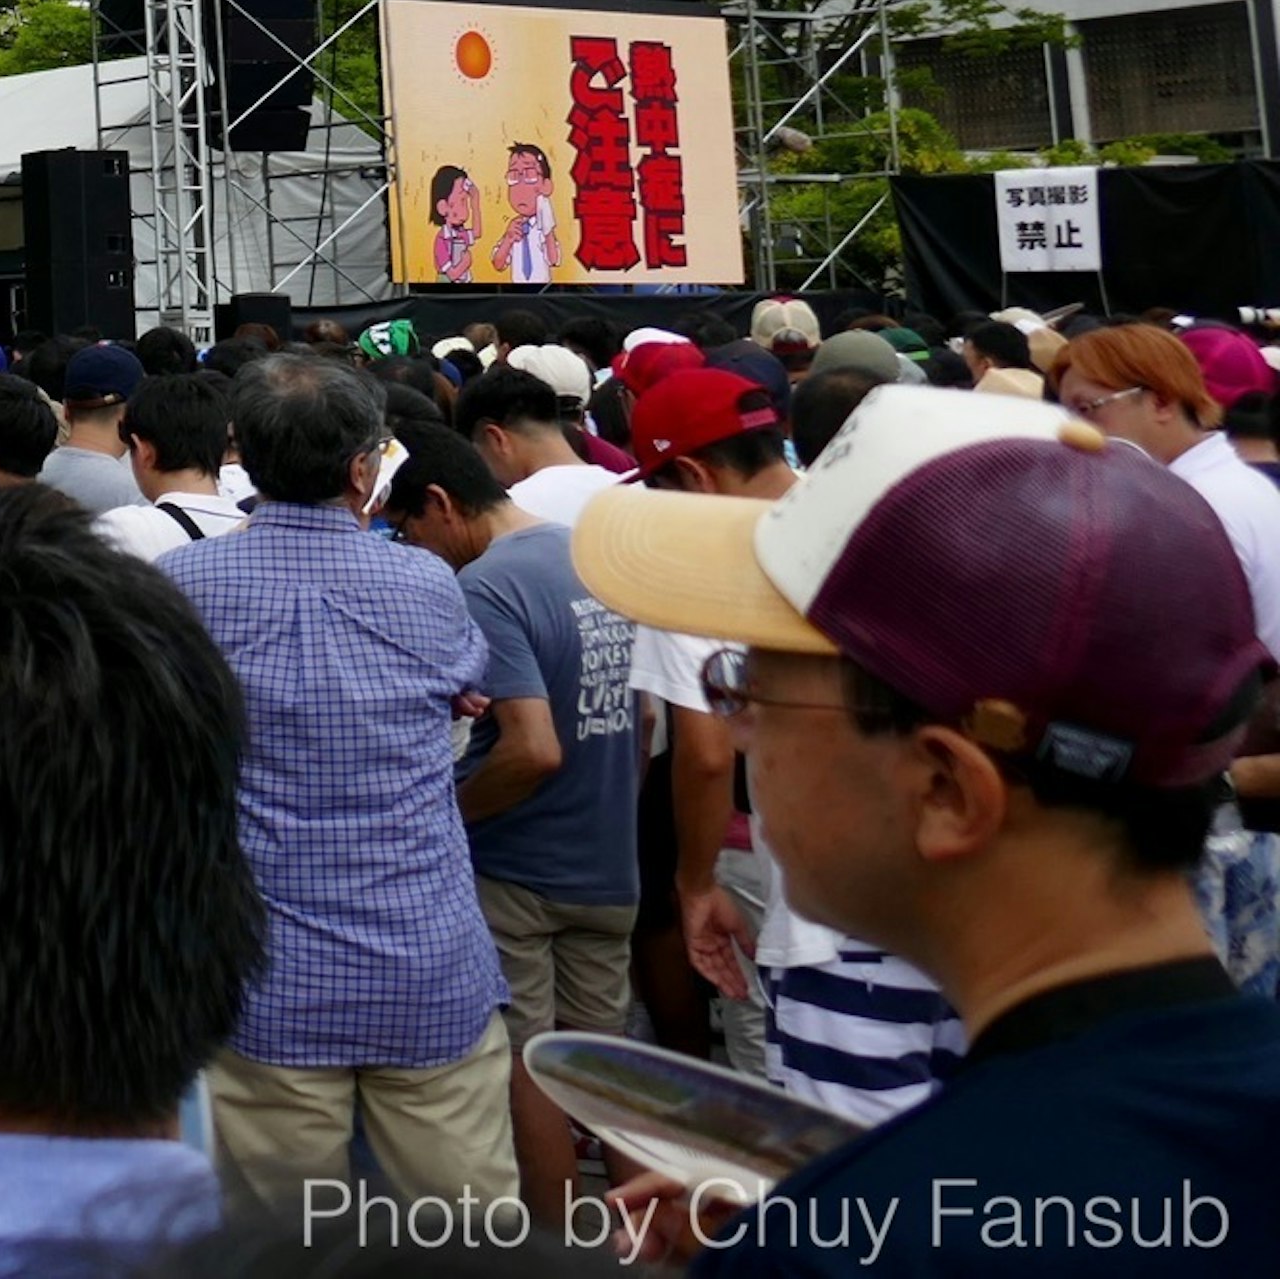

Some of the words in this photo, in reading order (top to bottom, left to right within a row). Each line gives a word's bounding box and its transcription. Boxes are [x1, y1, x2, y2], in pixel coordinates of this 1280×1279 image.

[566, 35, 641, 273] ご注意
[629, 40, 687, 269] 熱中症に
[1006, 184, 1088, 208] 写真撮影
[1015, 220, 1083, 250] 禁止
